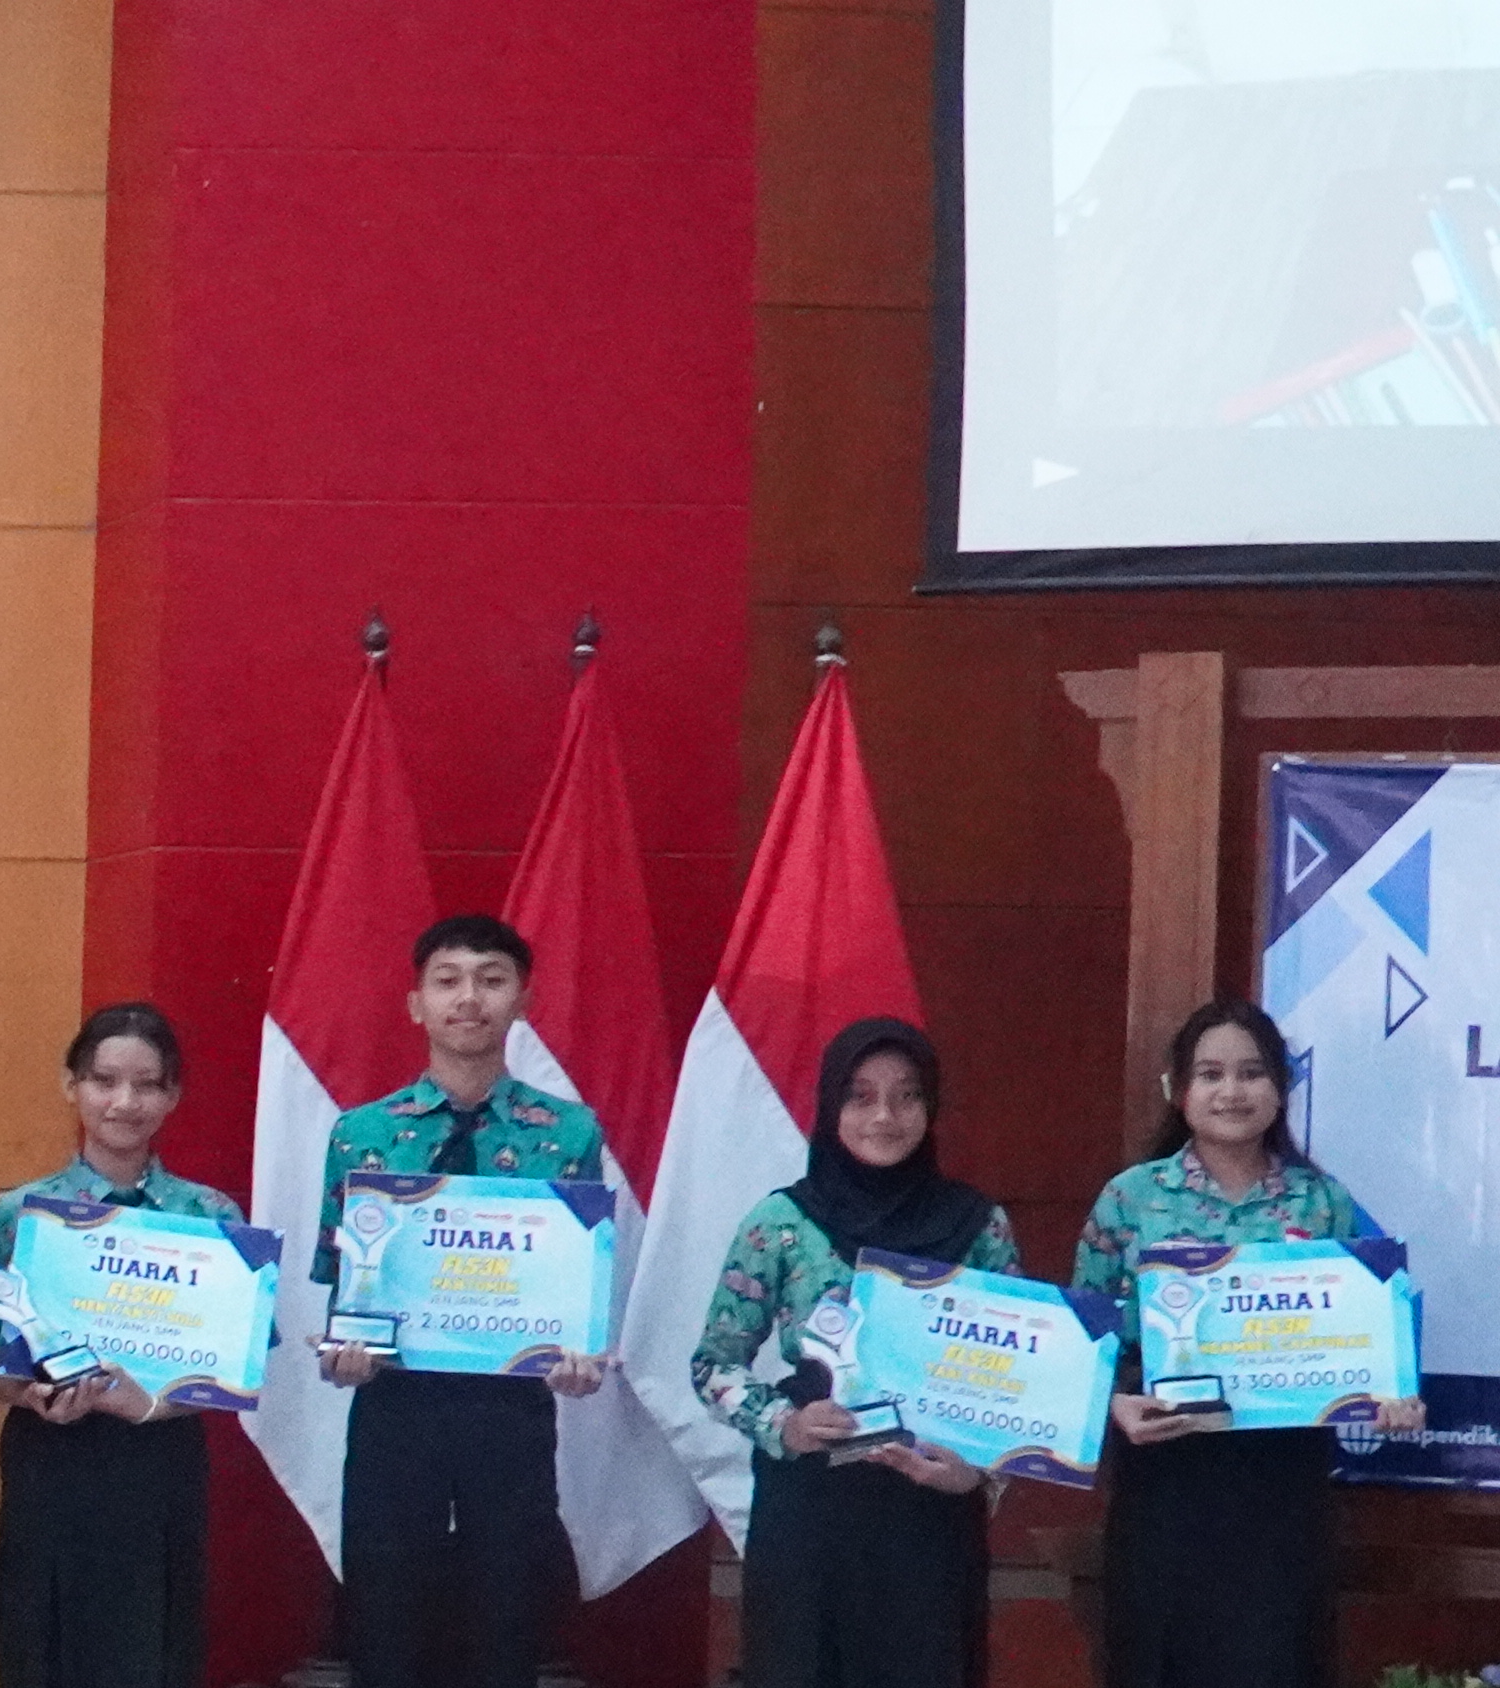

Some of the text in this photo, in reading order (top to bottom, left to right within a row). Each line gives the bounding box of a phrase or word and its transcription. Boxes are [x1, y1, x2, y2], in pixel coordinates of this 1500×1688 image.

[422, 1228, 534, 1252] JUARA 1
[90, 1255, 199, 1286] JUARA 1
[1220, 1291, 1332, 1313] JUARA 1
[421, 1312, 563, 1337] 2.200.000,00
[928, 1316, 1038, 1354] JUARA 1
[1228, 1368, 1372, 1390] 3.300.000,00
[916, 1398, 1059, 1439] 5.500.000,00
